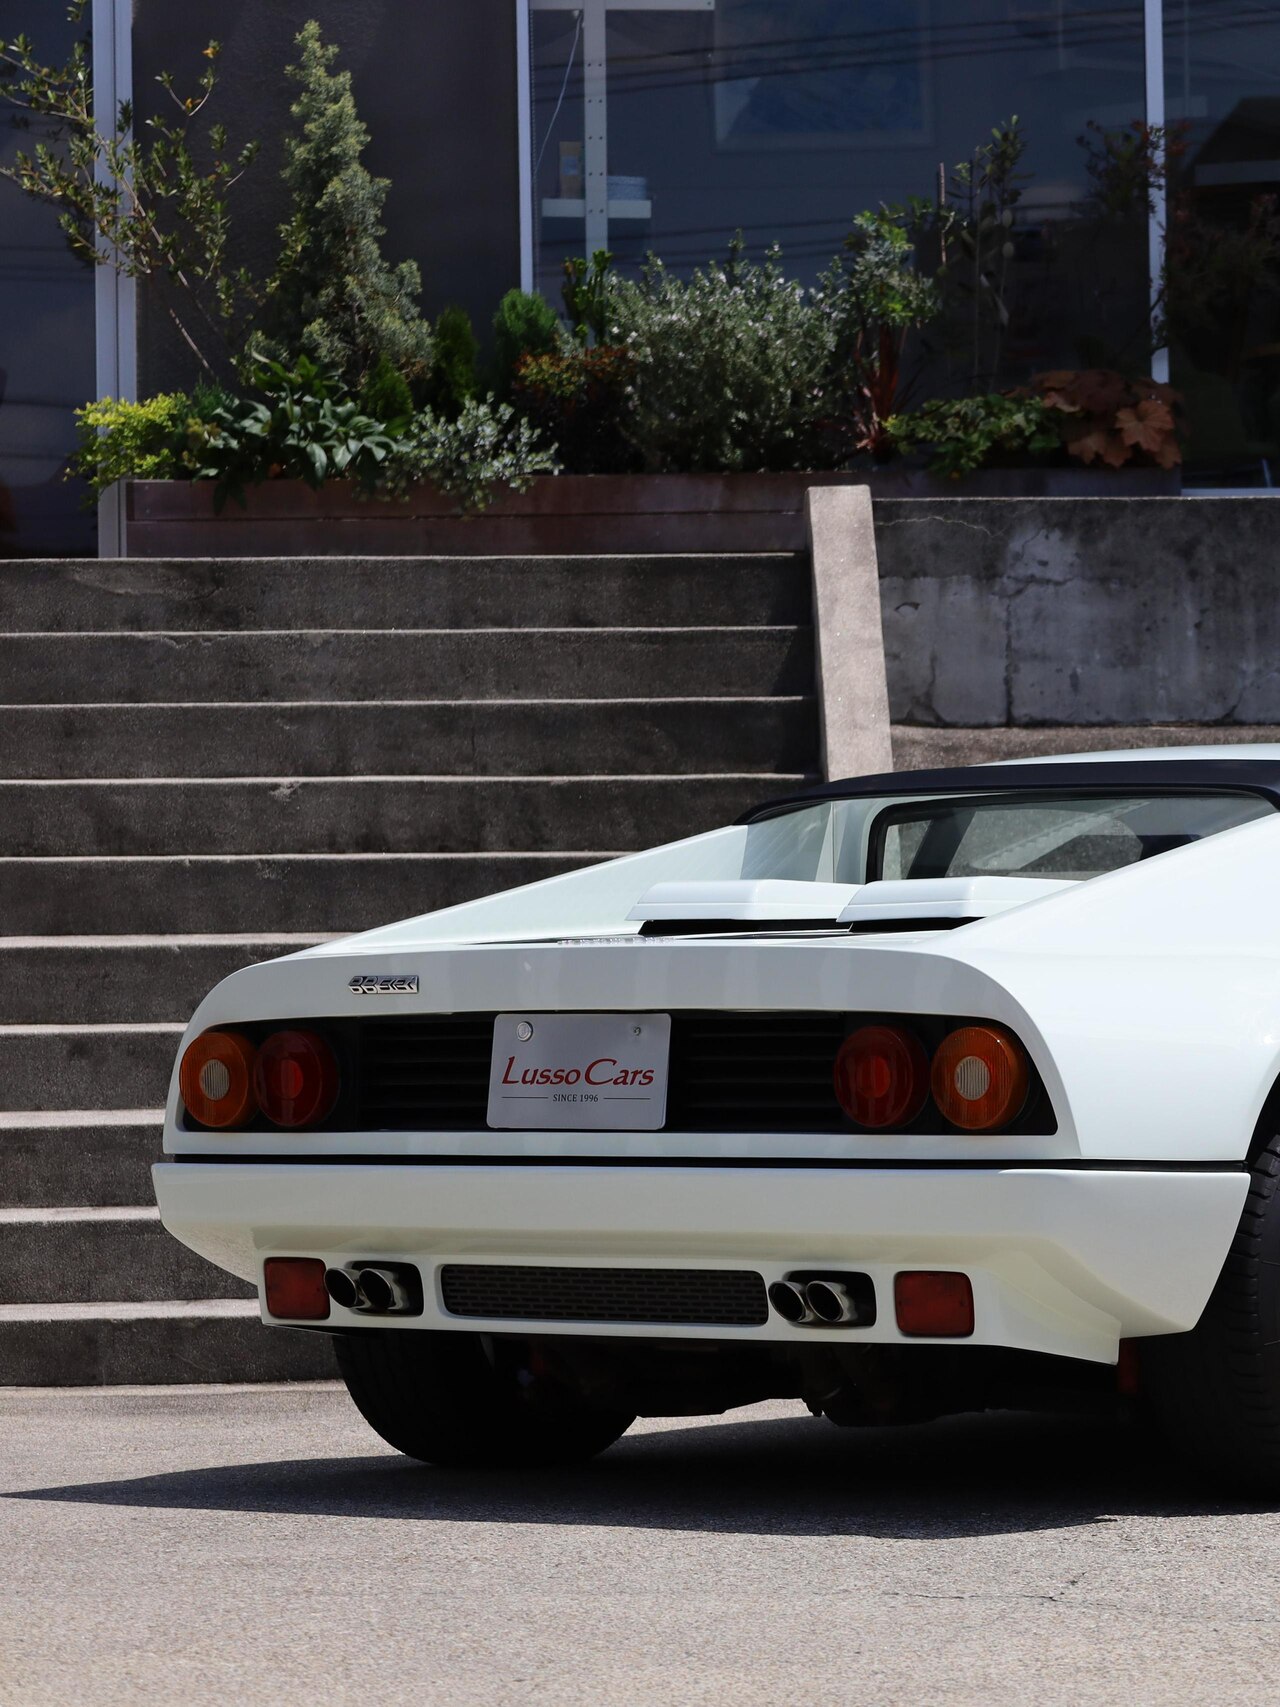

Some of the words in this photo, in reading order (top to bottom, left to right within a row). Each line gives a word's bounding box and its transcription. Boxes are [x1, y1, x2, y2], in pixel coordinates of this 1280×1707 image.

[502, 1055, 581, 1086] Lusso
[584, 1057, 655, 1086] Cars
[552, 1093, 578, 1103] SINCE
[579, 1093, 599, 1103] 1996
